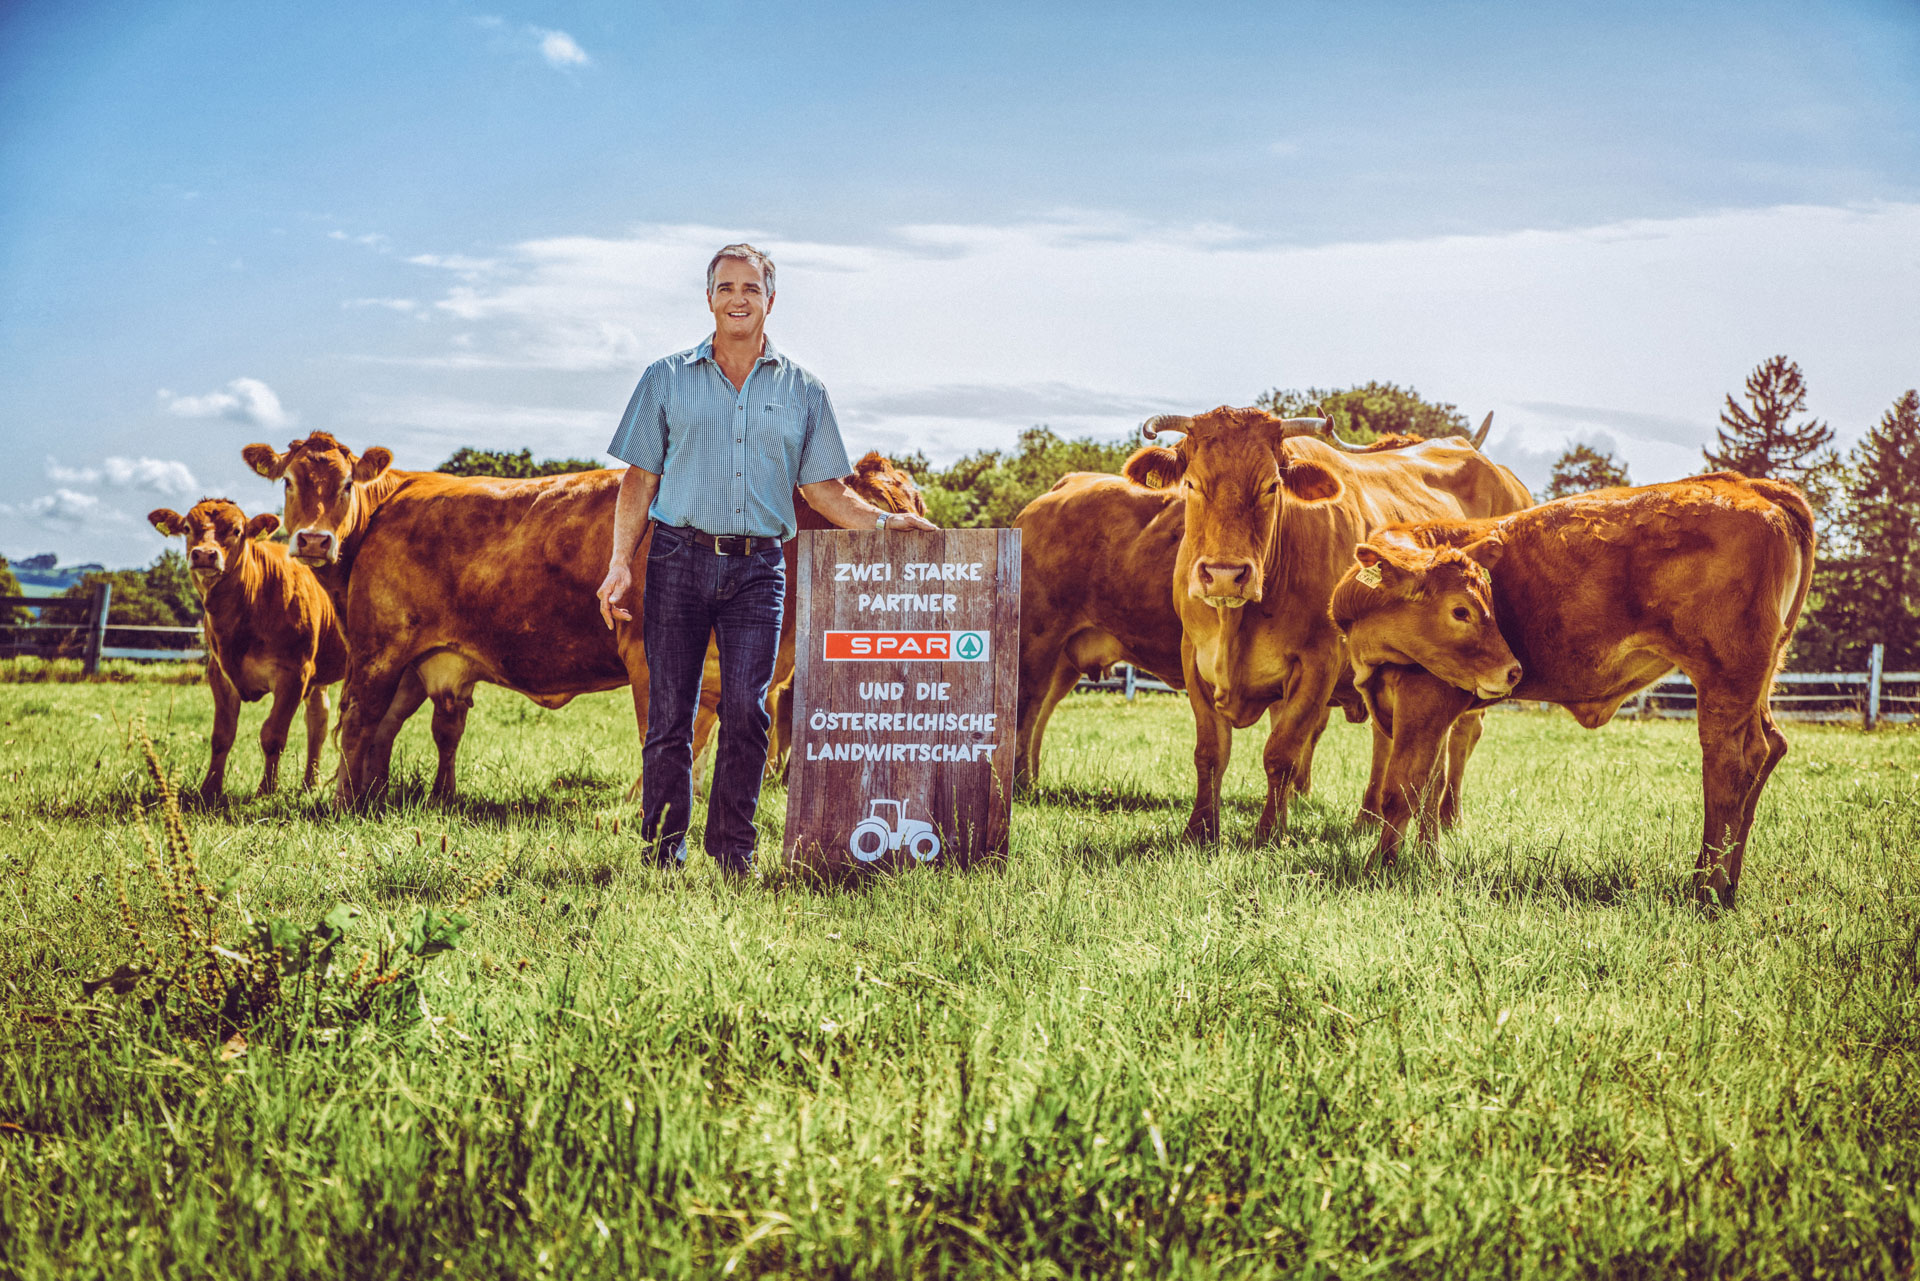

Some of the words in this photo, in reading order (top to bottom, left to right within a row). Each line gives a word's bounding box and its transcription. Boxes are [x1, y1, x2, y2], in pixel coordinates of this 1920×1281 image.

[834, 562, 891, 582] ZWEI
[903, 562, 983, 582] STARKE
[858, 593, 957, 612] PARTNER
[850, 637, 948, 655] SPAR
[859, 682, 904, 701] UND
[916, 682, 951, 701] DIE
[809, 708, 997, 732] ÖSTERREICHISCHE
[806, 742, 997, 762] LANDWIRTSCHAFT
